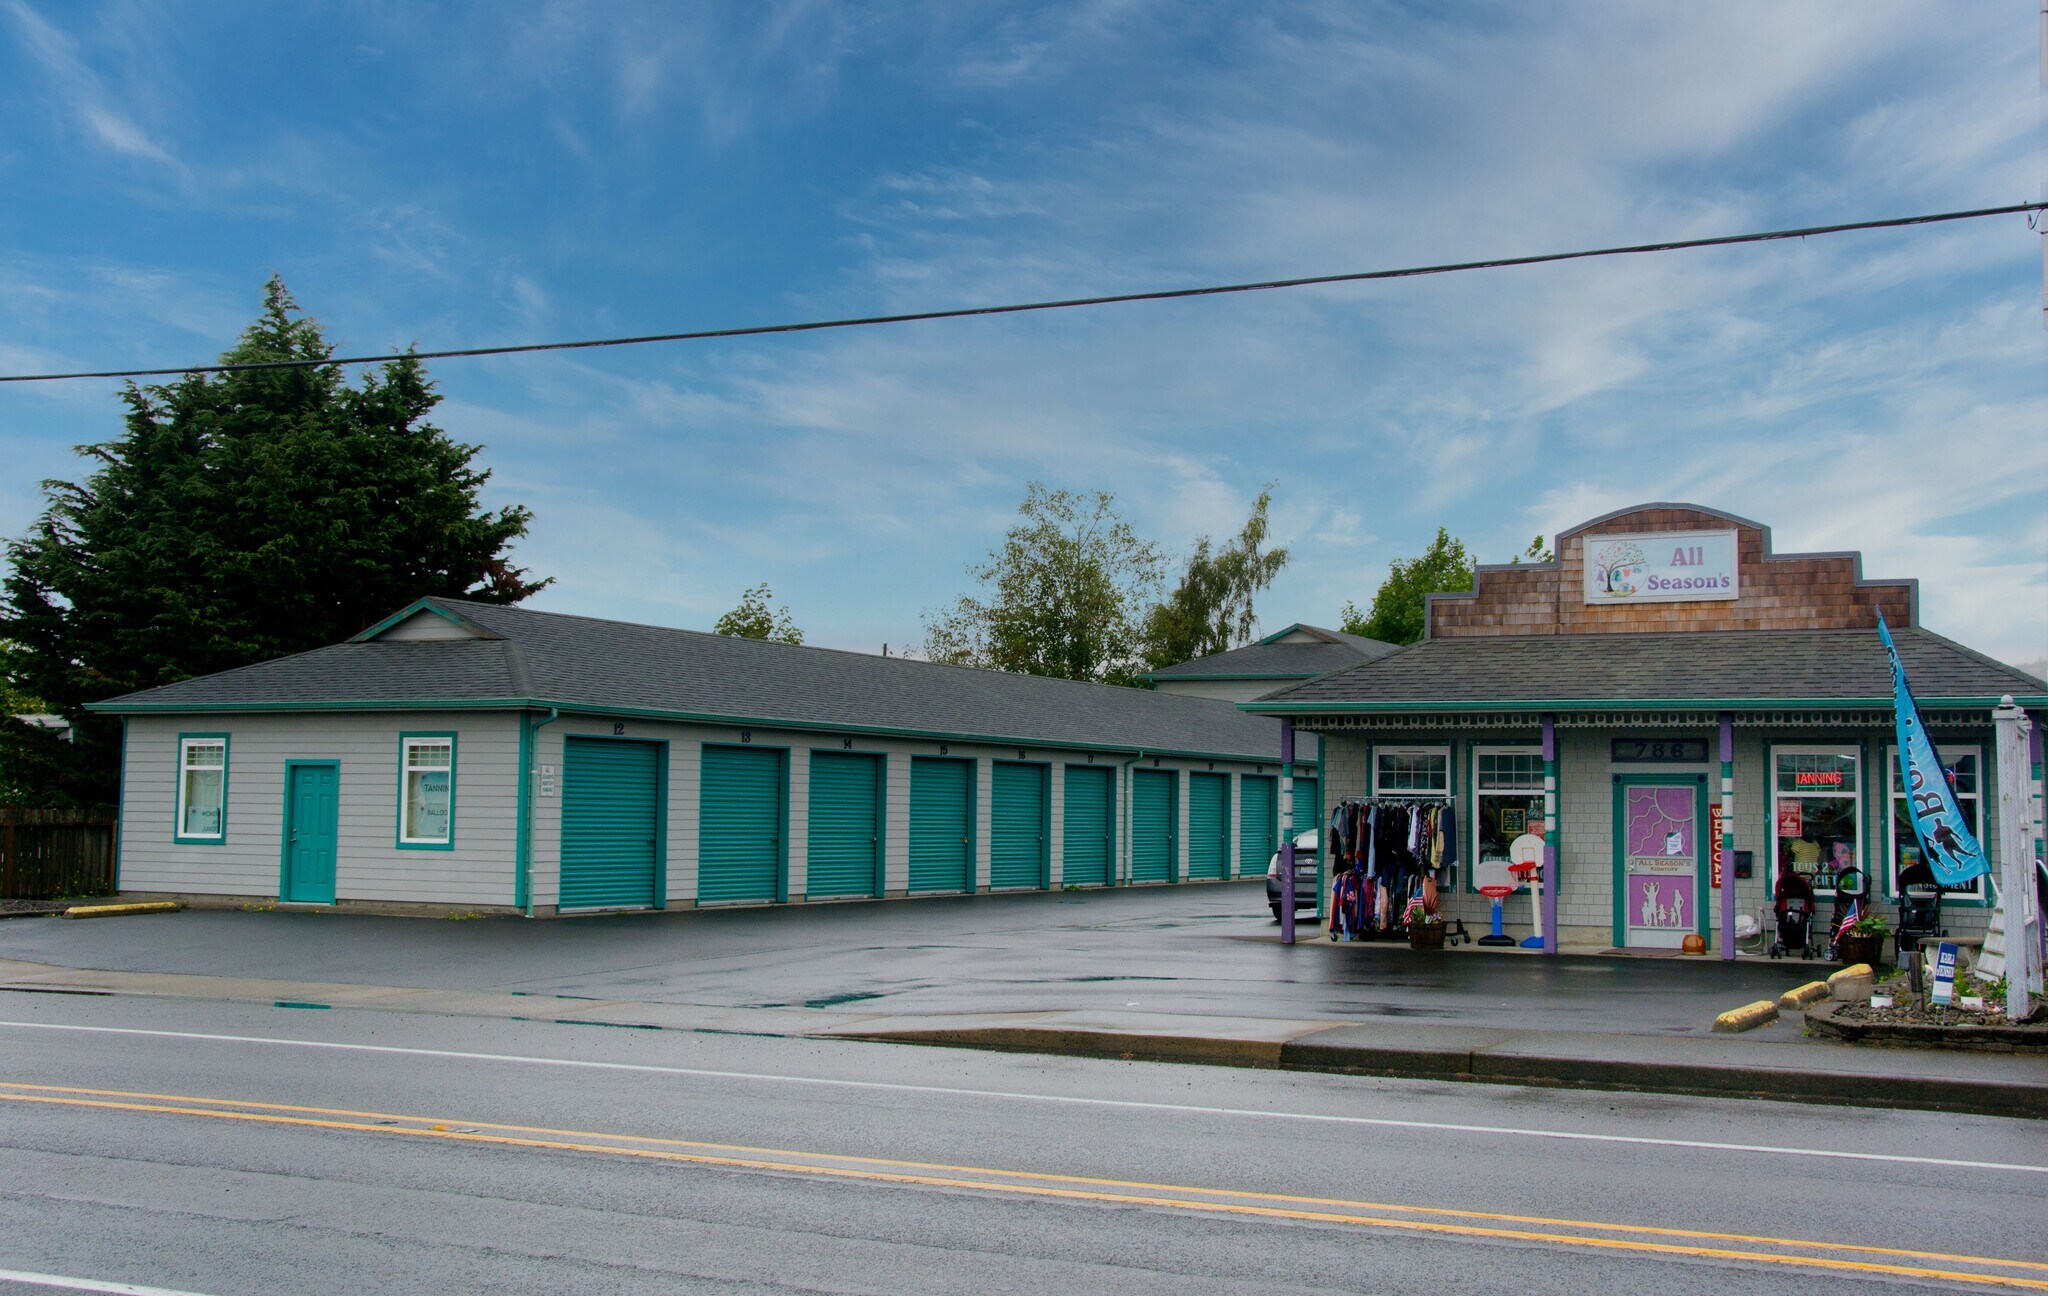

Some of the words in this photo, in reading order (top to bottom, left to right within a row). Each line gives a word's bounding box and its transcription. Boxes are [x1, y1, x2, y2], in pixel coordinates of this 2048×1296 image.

[1670, 546, 1704, 567] All
[1647, 572, 1730, 590] Season's
[613, 722, 624, 736] 12
[741, 731, 751, 744] 13
[939, 745, 948, 755] 15
[1635, 743, 1684, 758] 786
